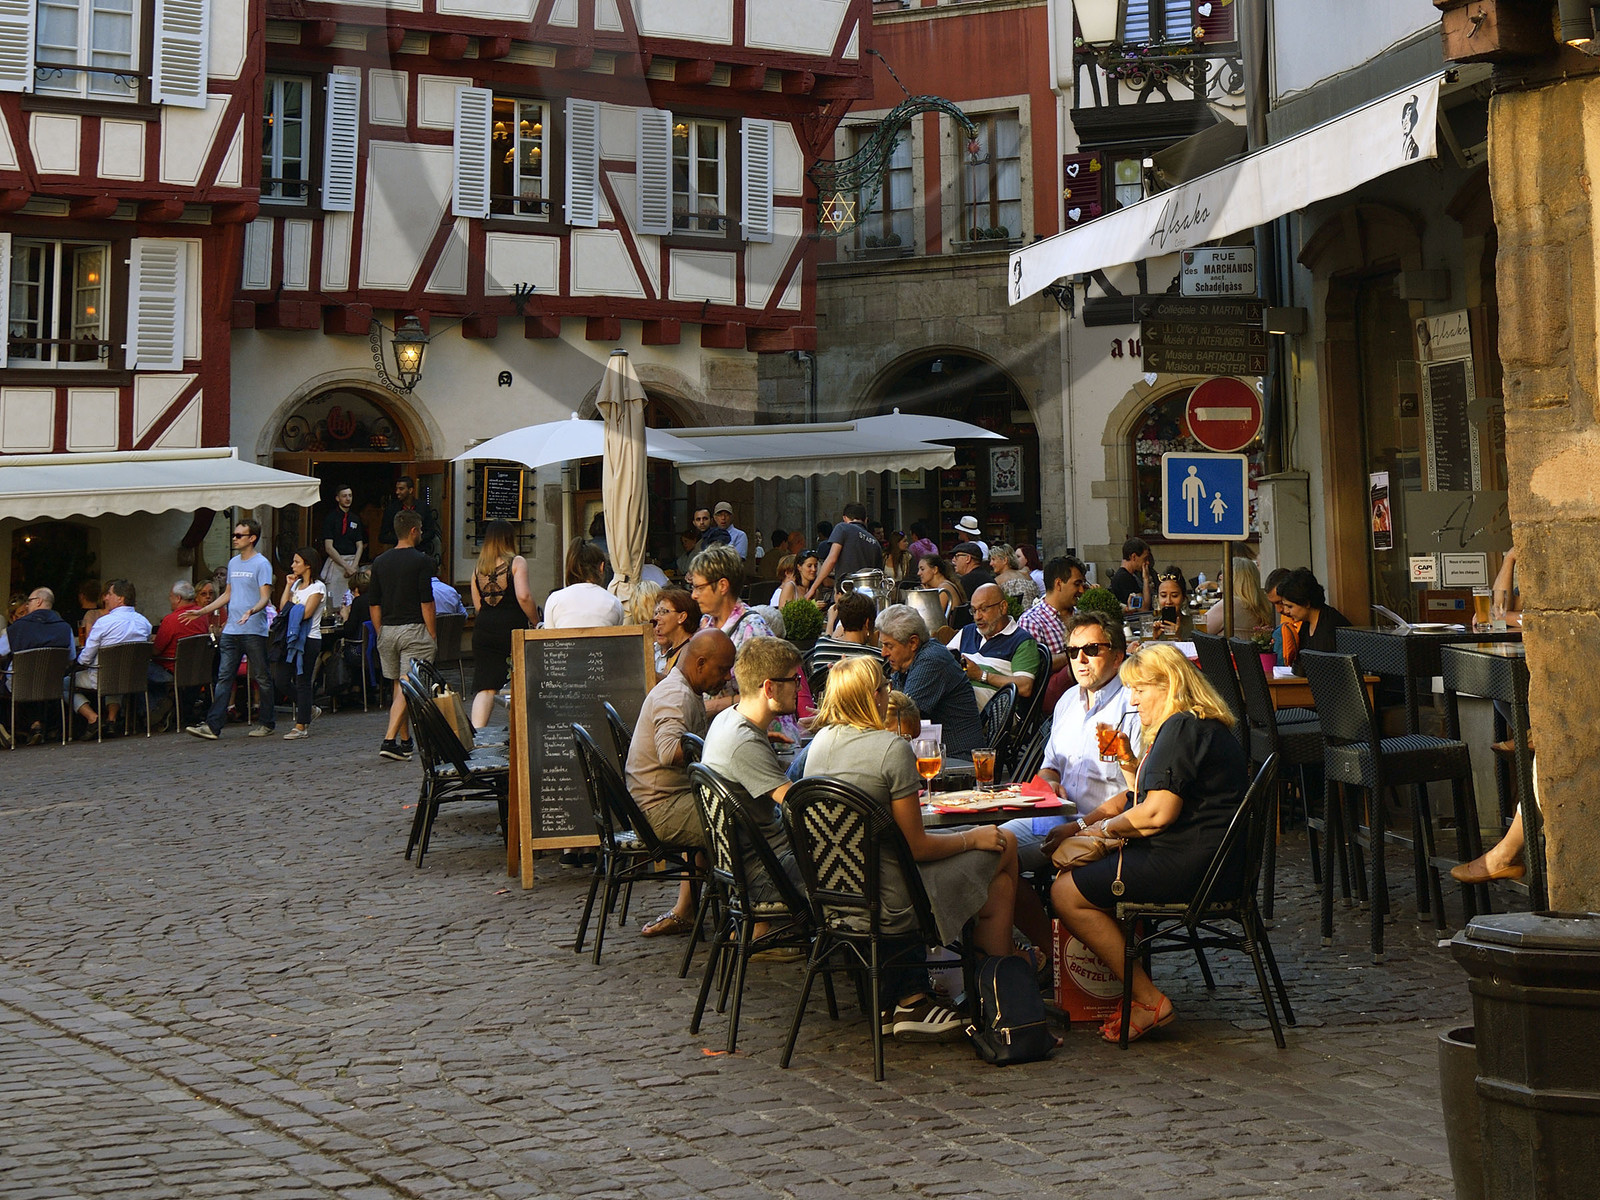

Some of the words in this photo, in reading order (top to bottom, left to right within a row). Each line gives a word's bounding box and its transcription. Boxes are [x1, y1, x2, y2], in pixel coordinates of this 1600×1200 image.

[1212, 253, 1235, 261] RUE
[1204, 263, 1253, 274] MARCHANDS
[1158, 304, 1196, 316] Collégiale
[1211, 306, 1244, 315] MARTIN
[1176, 324, 1198, 334] Office
[1201, 326, 1210, 334] du
[1214, 325, 1245, 336] Tourisme
[1162, 336, 1186, 345] Musée
[1197, 336, 1246, 346] UNTERLINDEN
[1164, 351, 1193, 361] Musée
[1196, 352, 1246, 362] BARTHOLDI
[1165, 361, 1200, 372] Maison
[1204, 363, 1247, 373] PFISTER
[1070, 962, 1107, 982] BRETZEL
